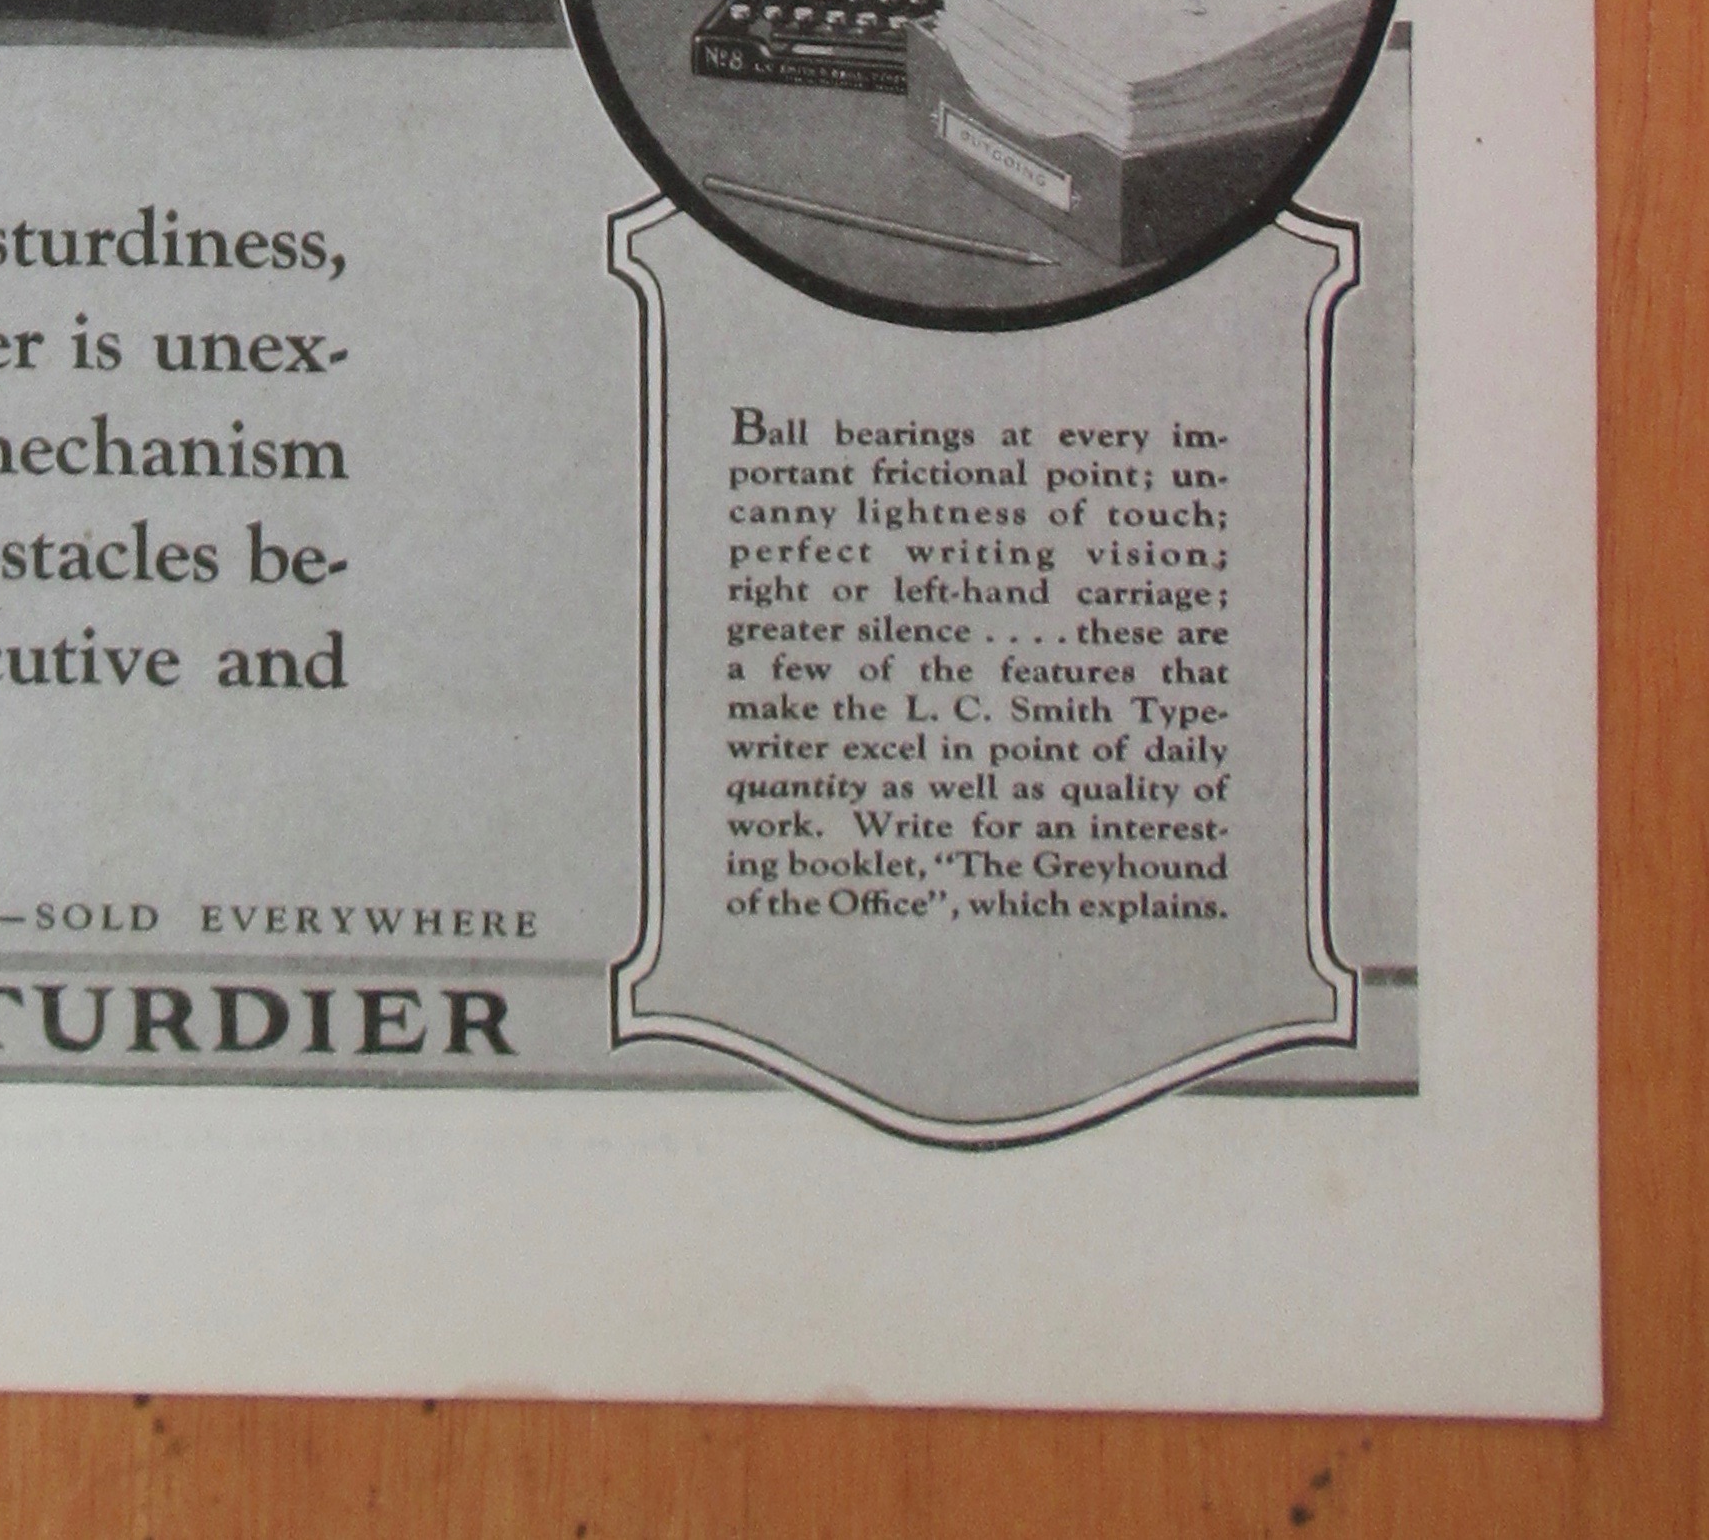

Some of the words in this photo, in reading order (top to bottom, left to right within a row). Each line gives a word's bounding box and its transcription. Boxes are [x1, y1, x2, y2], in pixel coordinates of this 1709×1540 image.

[71, 312, 122, 371] is
[153, 334, 348, 373] unex-
[732, 407, 808, 446] Ball
[836, 419, 975, 453] bearings
[1001, 426, 1032, 447] at
[1058, 429, 1149, 453] every
[1173, 422, 1228, 448] im-
[729, 465, 854, 491] portant
[872, 456, 1027, 486] frictional
[1046, 467, 1153, 493] point;
[1172, 469, 1228, 488] un-
[729, 505, 836, 529] canny
[857, 496, 1027, 530] lightness
[1048, 497, 1087, 526] of
[1108, 500, 1227, 531] touch;
[247, 521, 348, 586] be-
[730, 535, 871, 570] perfect
[906, 538, 1055, 572] writing
[728, 575, 809, 608] right
[832, 584, 869, 602] or
[894, 574, 1049, 604] left-hand
[1076, 587, 1228, 612] carriage;
[727, 620, 845, 647] greater
[858, 615, 971, 643] silence
[1077, 617, 1163, 646] these
[1177, 627, 1229, 646] are
[218, 629, 348, 690] and
[727, 662, 745, 680] a
[772, 656, 832, 681] few
[859, 653, 895, 682] of
[920, 654, 973, 683] the
[1001, 655, 1135, 684] features
[1162, 656, 1228, 685] that
[728, 692, 819, 721] make
[833, 694, 887, 721] the
[907, 694, 938, 722] L.
[953, 696, 991, 723] C.
[1011, 696, 1113, 723] Smith
[1130, 696, 1228, 730] Type-
[727, 733, 829, 760] writer
[843, 732, 926, 761] excel
[942, 739, 974, 761] in
[990, 741, 1079, 767] point
[1092, 733, 1130, 762] of
[1144, 734, 1227, 766] daily
[726, 773, 867, 805] quantity
[882, 781, 914, 799] as
[929, 773, 998, 800] well
[1012, 782, 1045, 801] as
[1060, 773, 1179, 807] quality
[1193, 773, 1231, 802] of
[727, 810, 823, 838] work.
[853, 810, 953, 839] Write
[972, 810, 1022, 839] for
[1036, 821, 1076, 840] an
[1091, 814, 1228, 841] interest-
[727, 850, 778, 883] ing
[788, 849, 927, 881] booklet,
[1033, 852, 1228, 883] Greyhound
[202, 905, 537, 939] EVERYWHERE
[726, 887, 763, 915] of
[767, 888, 821, 916] the
[969, 889, 1070, 917] which
[1079, 891, 1228, 925] explains.
